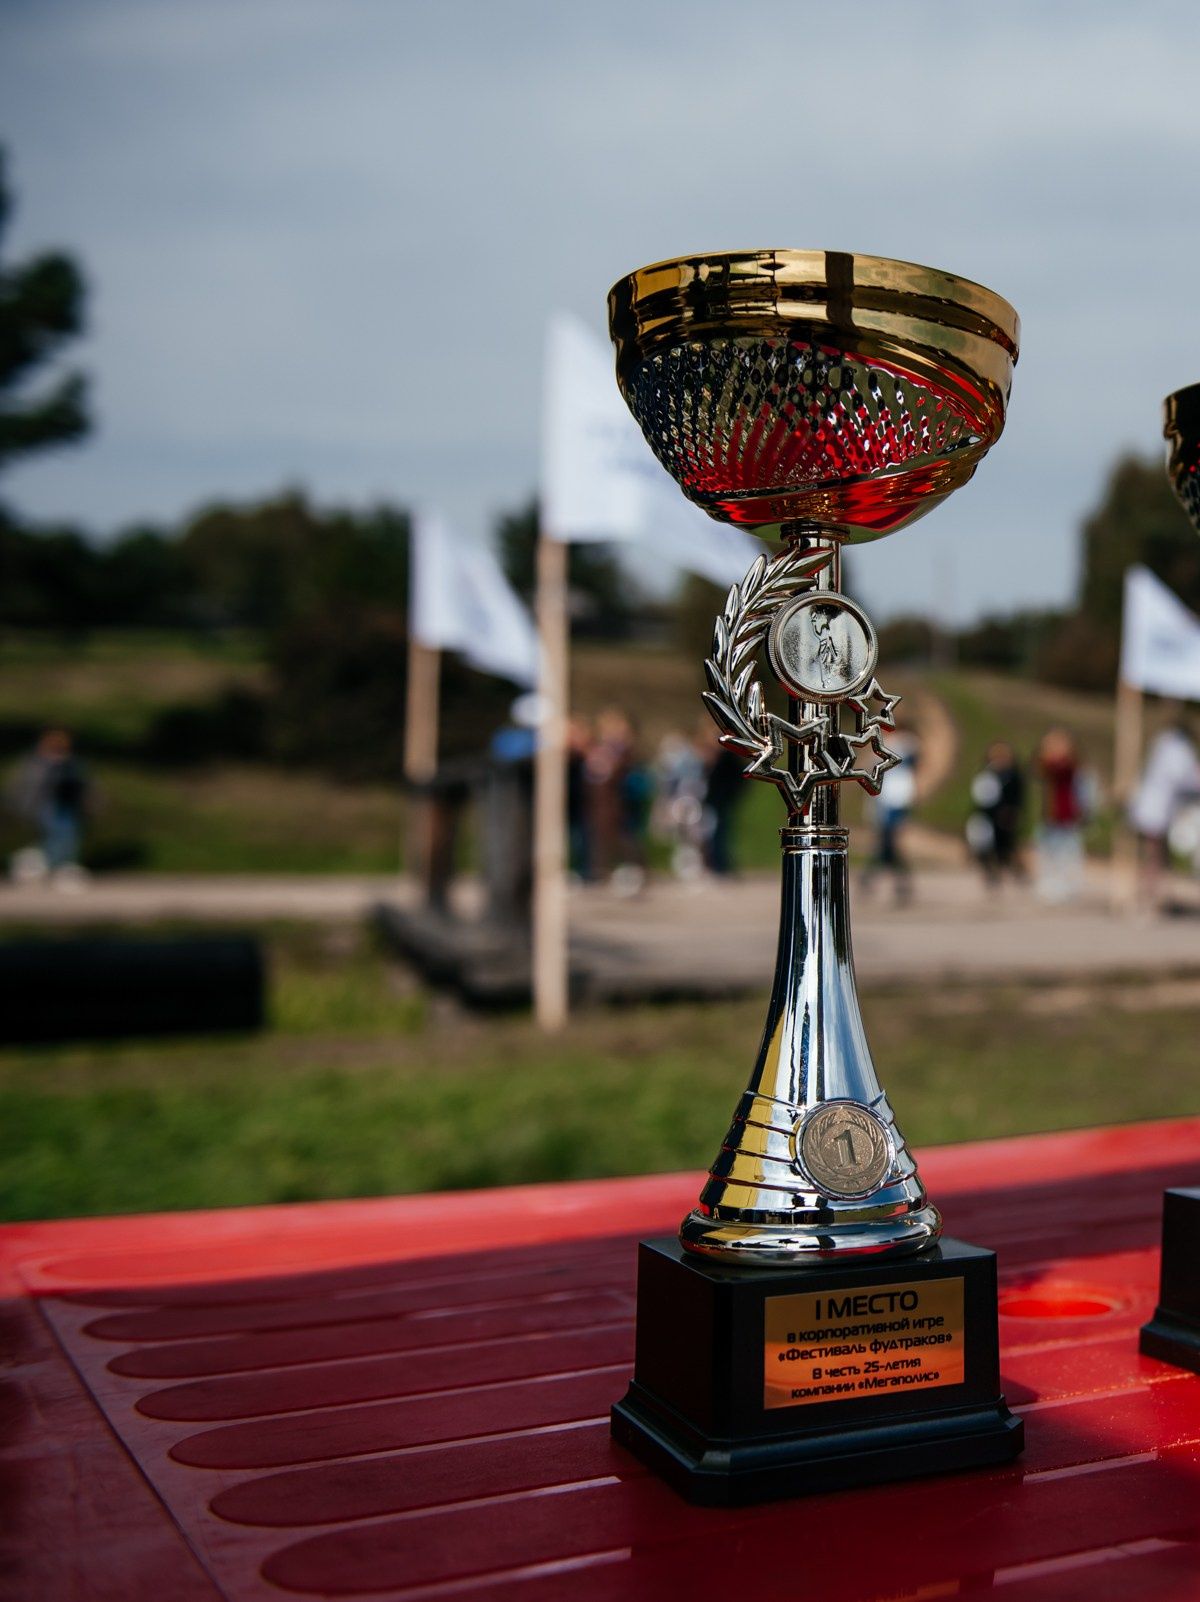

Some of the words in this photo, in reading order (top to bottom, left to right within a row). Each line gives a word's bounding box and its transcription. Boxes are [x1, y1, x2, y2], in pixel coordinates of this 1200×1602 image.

[833, 1129, 861, 1167] 1
[828, 1290, 919, 1319] МЕСТО
[787, 1332, 796, 1343] в
[799, 1317, 910, 1343] корпоративной
[912, 1315, 944, 1332] игре
[778, 1342, 866, 1361] «Фестиваль
[869, 1333, 953, 1354] фудтраков»
[825, 1364, 860, 1378] честь
[864, 1358, 921, 1373] 25-летия
[791, 1382, 855, 1399] компании
[858, 1371, 940, 1390] «Мегаполис»
